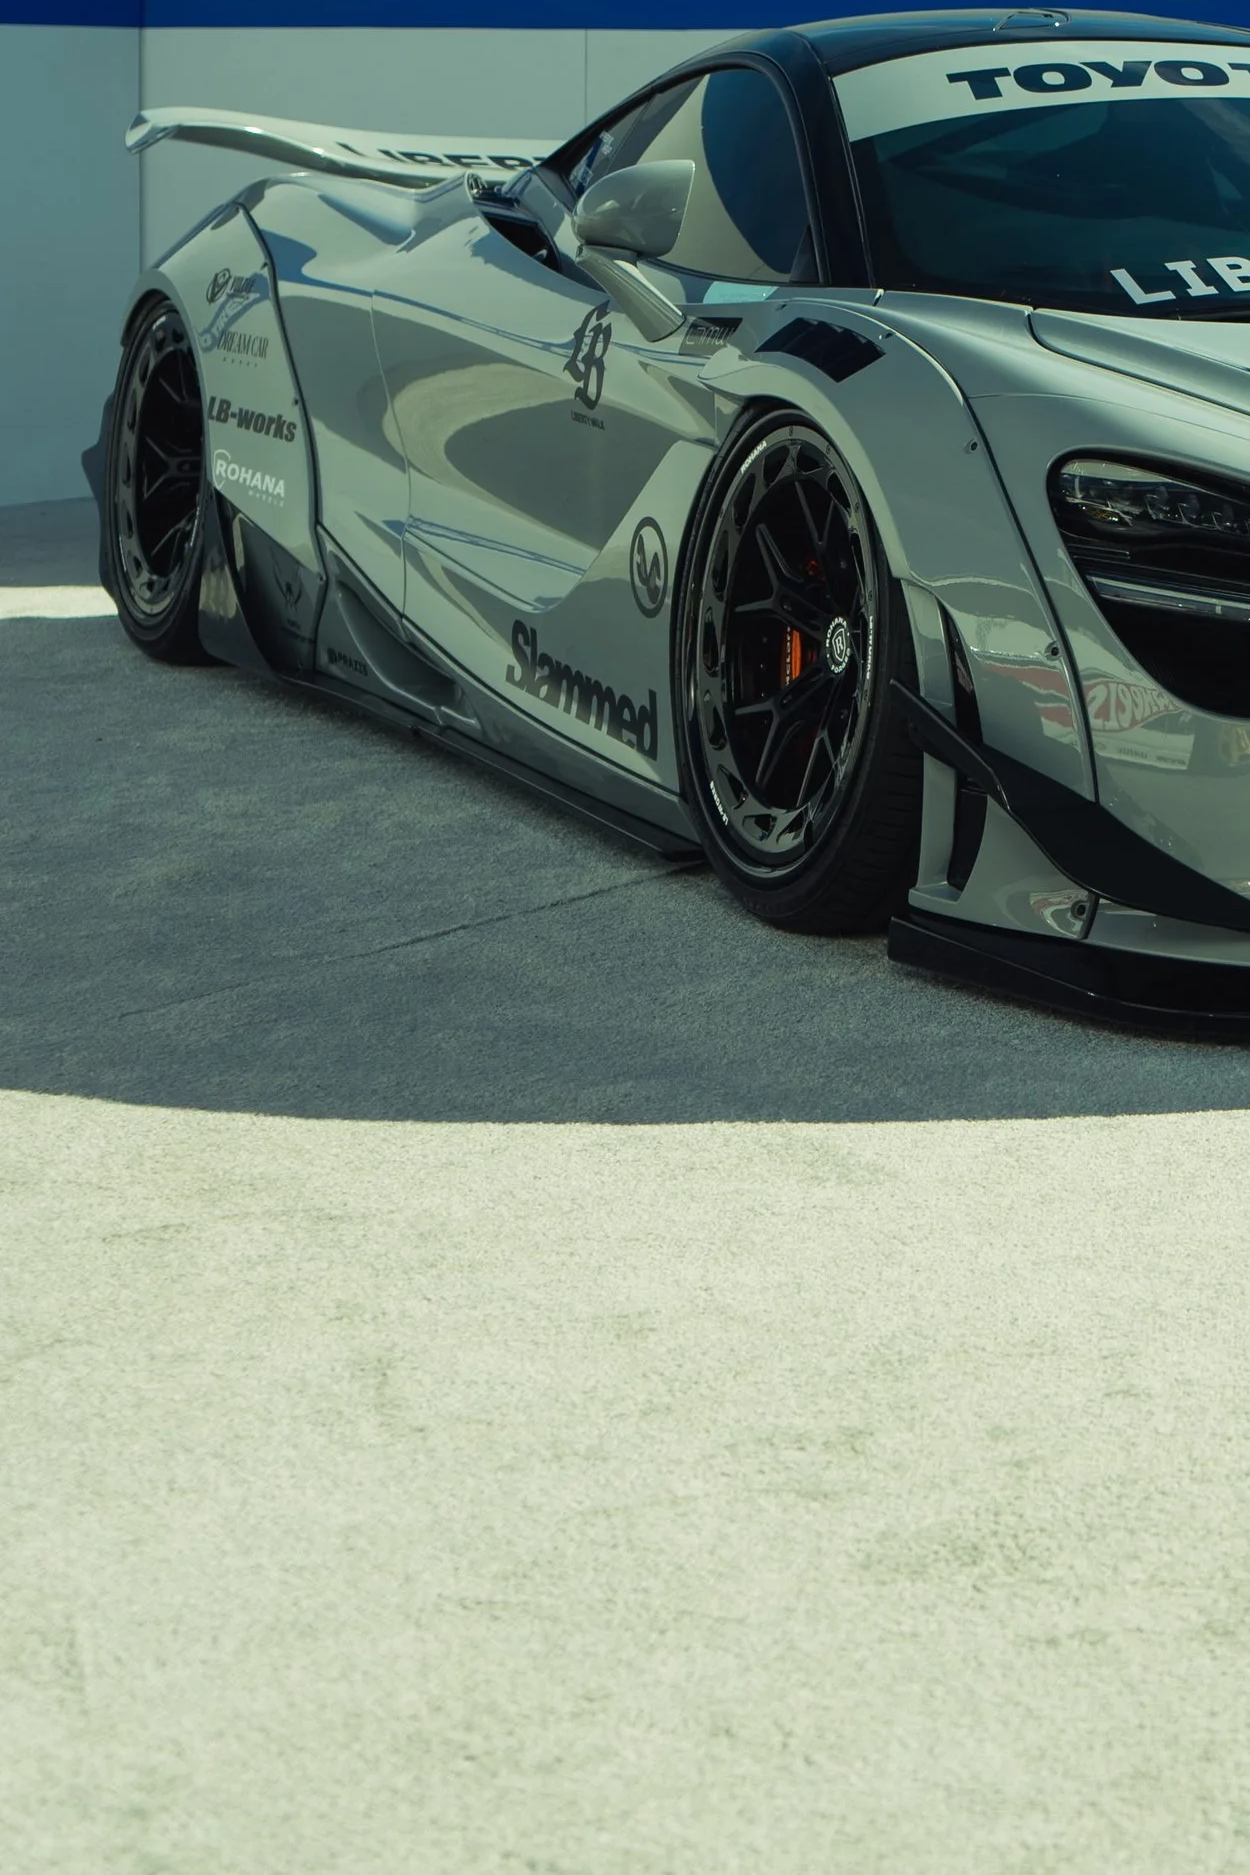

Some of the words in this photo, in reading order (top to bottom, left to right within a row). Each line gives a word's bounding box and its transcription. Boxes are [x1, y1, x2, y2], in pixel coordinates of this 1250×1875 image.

[946, 59, 1231, 101] TOYO
[250, 336, 269, 359] CAR
[208, 396, 297, 443] LB-works
[740, 440, 767, 475] ROHANA
[215, 459, 285, 498] ROHANA
[505, 619, 658, 761] Slammed
